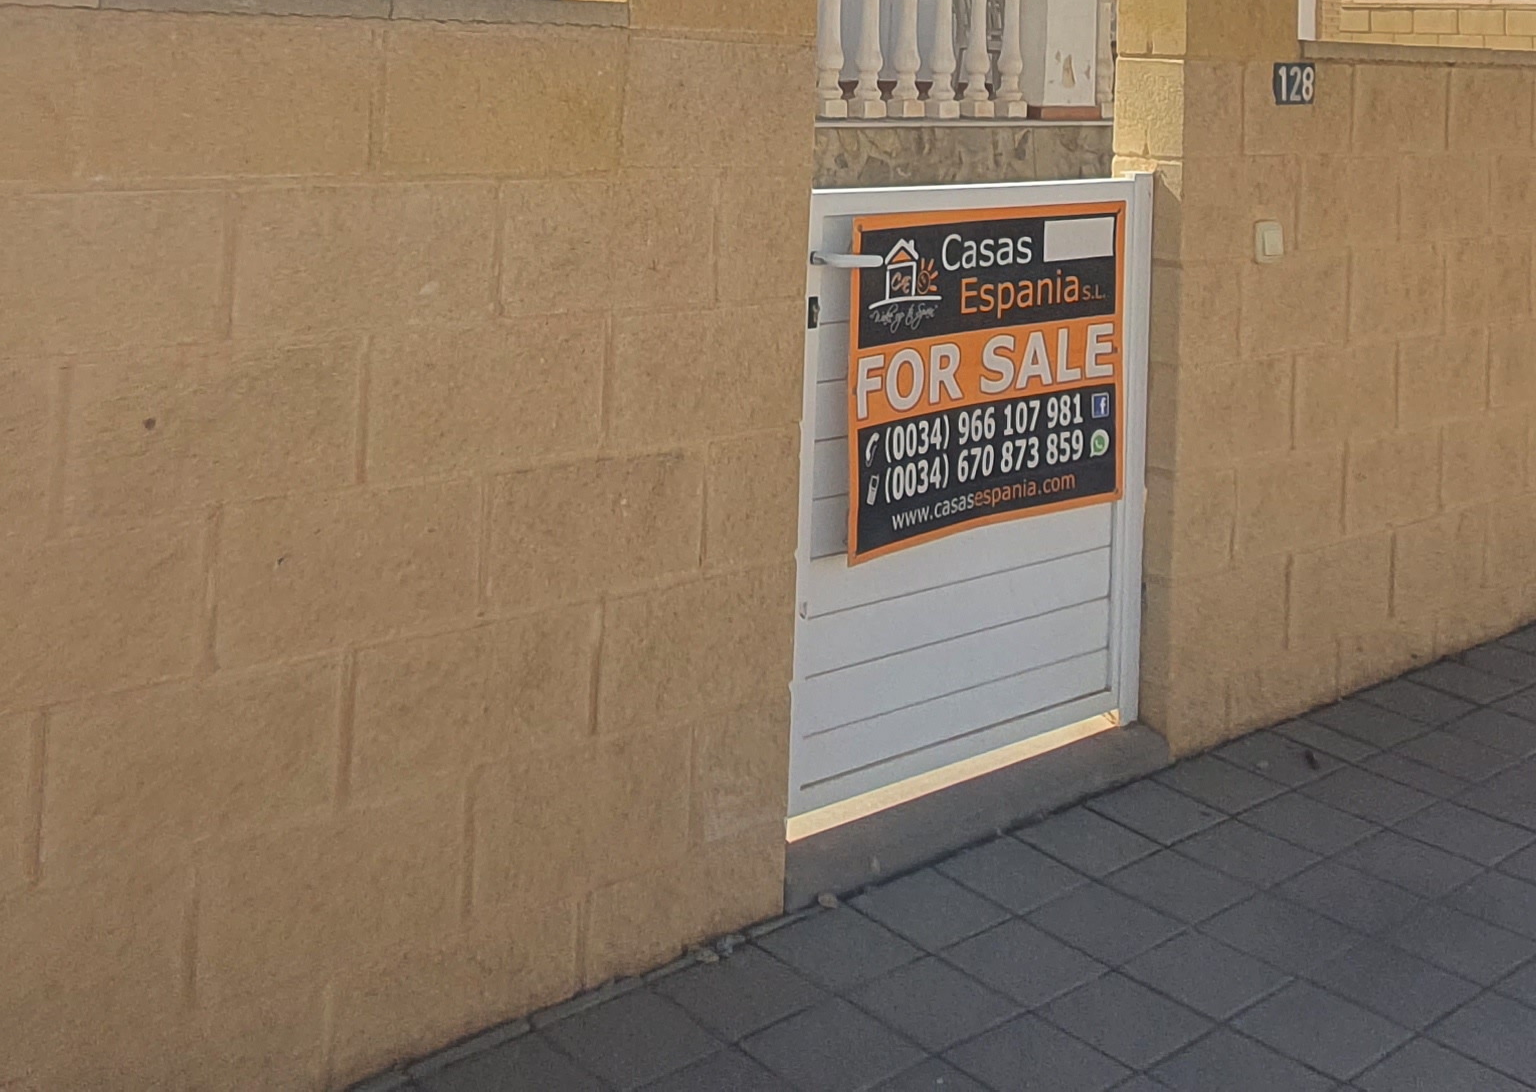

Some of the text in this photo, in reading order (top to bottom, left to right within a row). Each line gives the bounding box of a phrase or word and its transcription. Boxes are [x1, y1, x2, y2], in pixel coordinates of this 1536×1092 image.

[1278, 65, 1314, 102] 128
[941, 233, 1033, 271] Casas
[960, 269, 1080, 319] Espania
[856, 322, 1114, 421] FOR SALE
[884, 392, 1083, 463] (0034) 966 107 981
[884, 428, 1083, 504] (0034) 670 873 859
[891, 471, 1076, 531] www.casasespania.com
